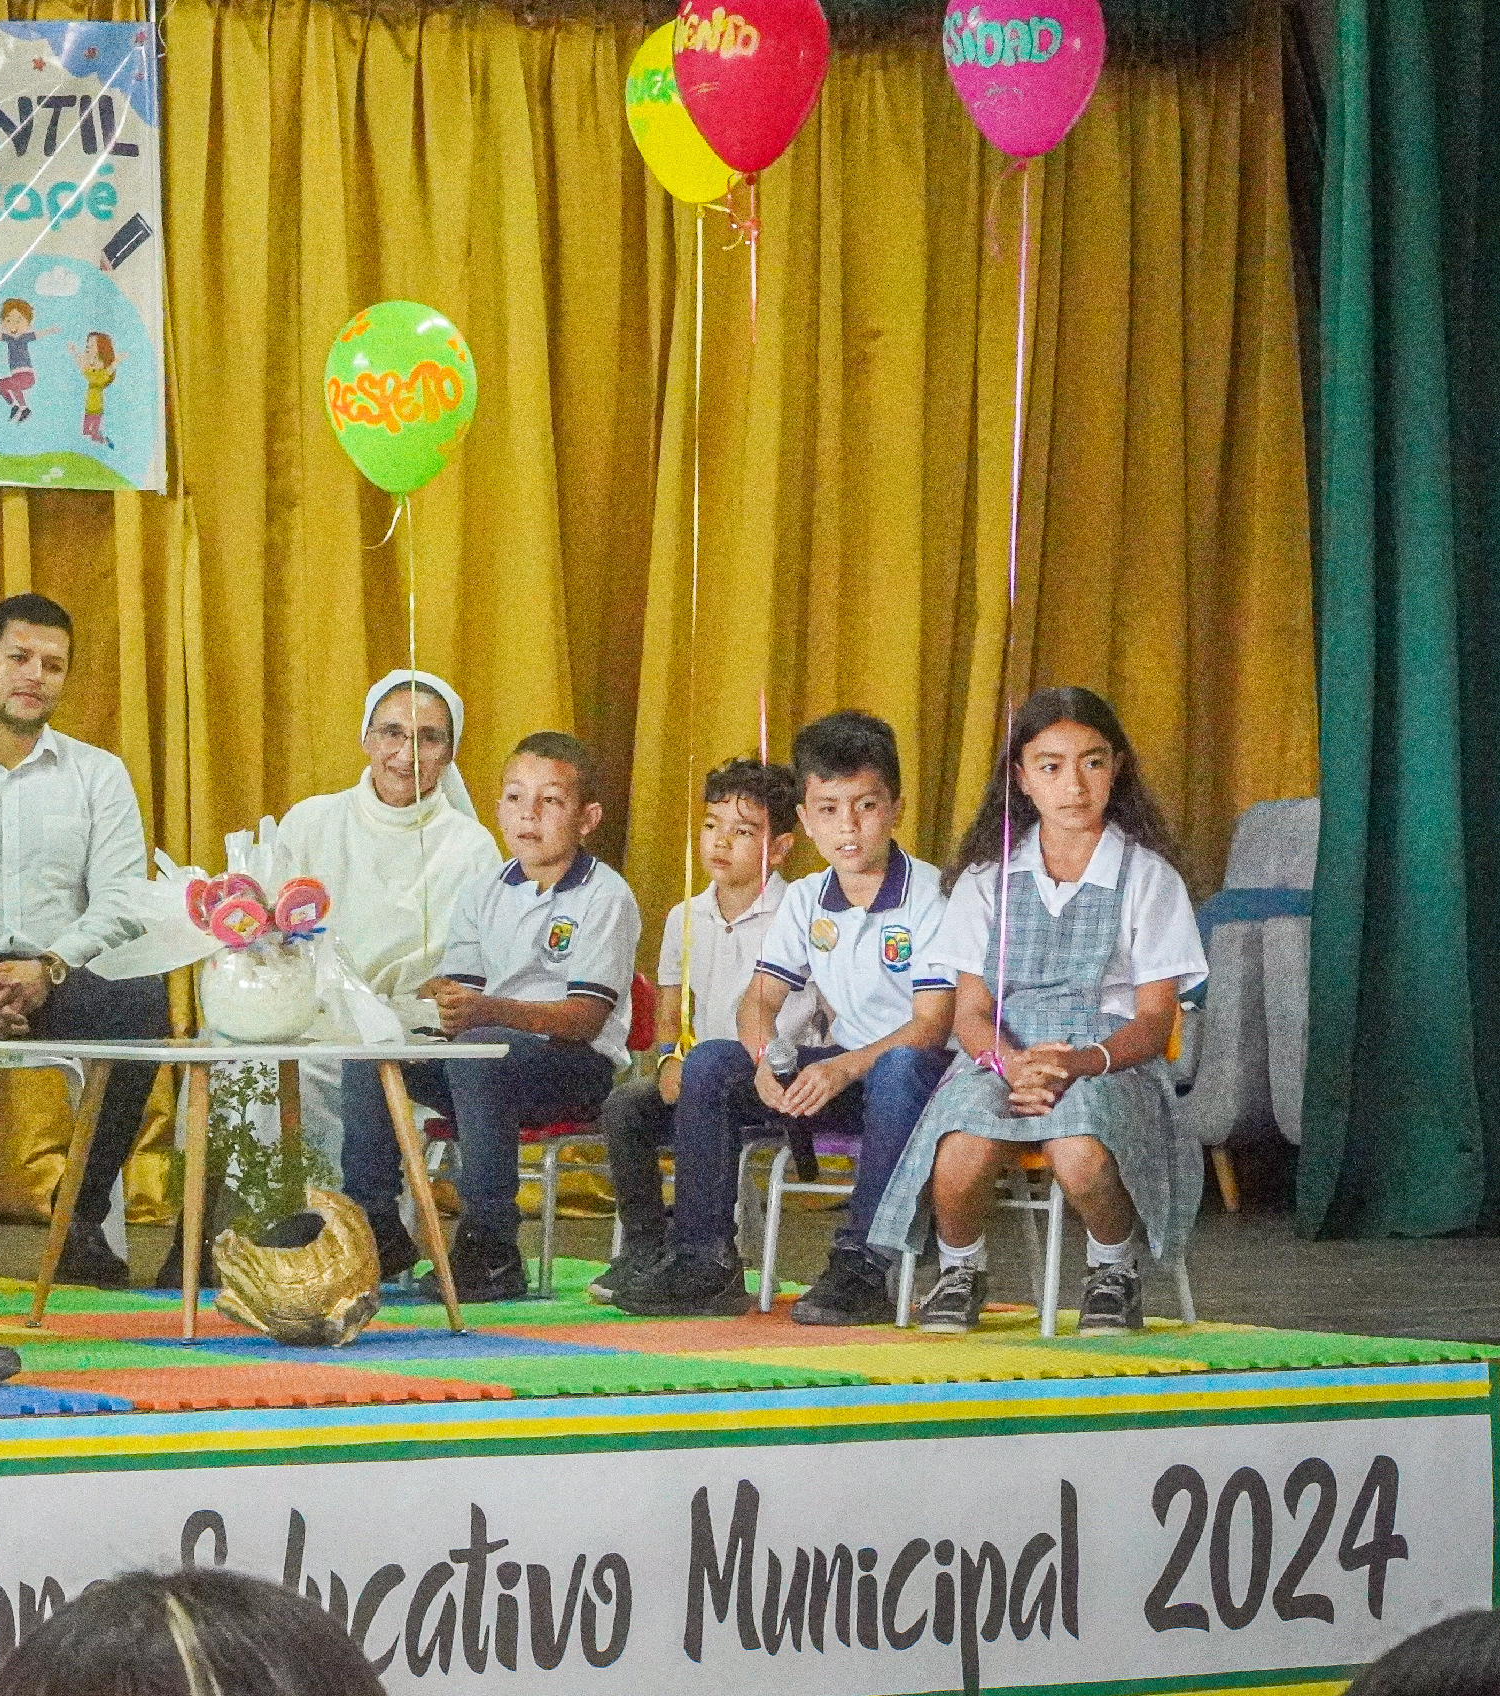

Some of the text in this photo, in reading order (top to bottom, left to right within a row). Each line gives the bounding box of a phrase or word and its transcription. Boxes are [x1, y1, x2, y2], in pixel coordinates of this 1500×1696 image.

[326, 360, 464, 434] RESPETO
[181, 1503, 633, 1677] cativo
[684, 1479, 1079, 1696] Municipal
[1144, 1455, 1408, 1632] 2024
